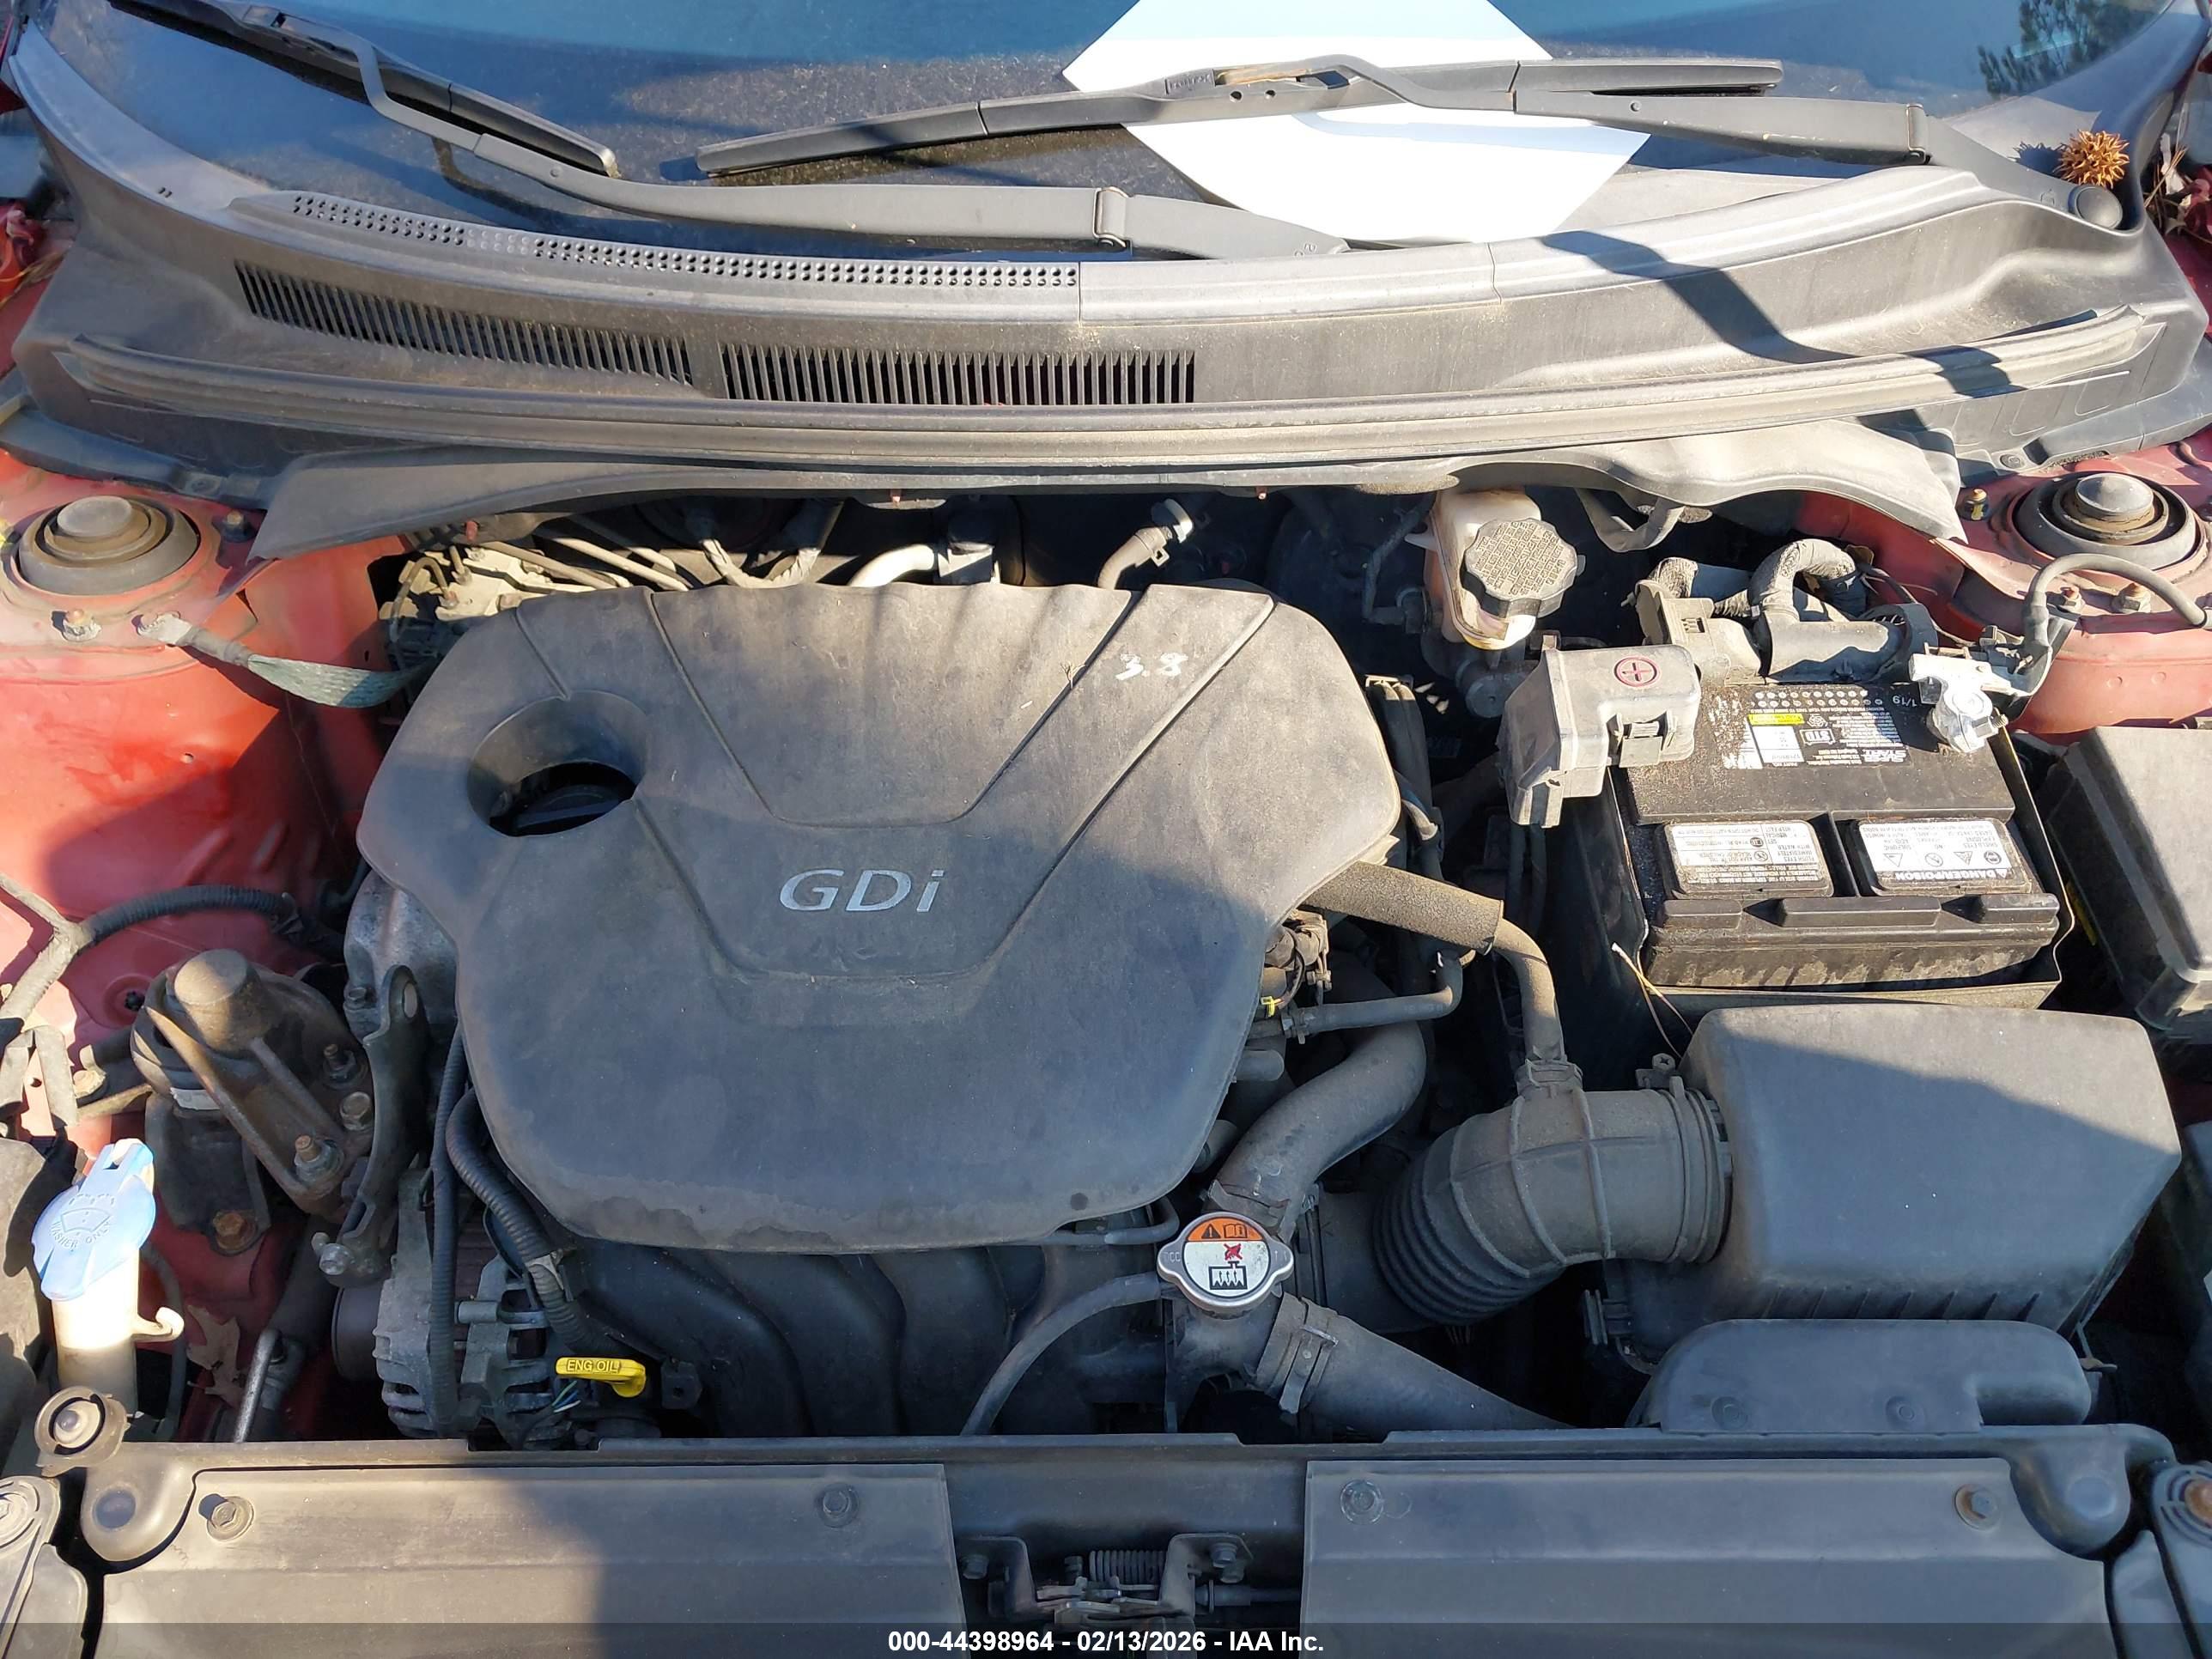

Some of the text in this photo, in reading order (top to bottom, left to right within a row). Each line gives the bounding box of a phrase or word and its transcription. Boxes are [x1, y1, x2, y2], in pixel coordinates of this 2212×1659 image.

[1804, 731, 1832, 742] STD
[779, 869, 945, 913] GDi
[567, 1359, 620, 1373] ENG OIL
